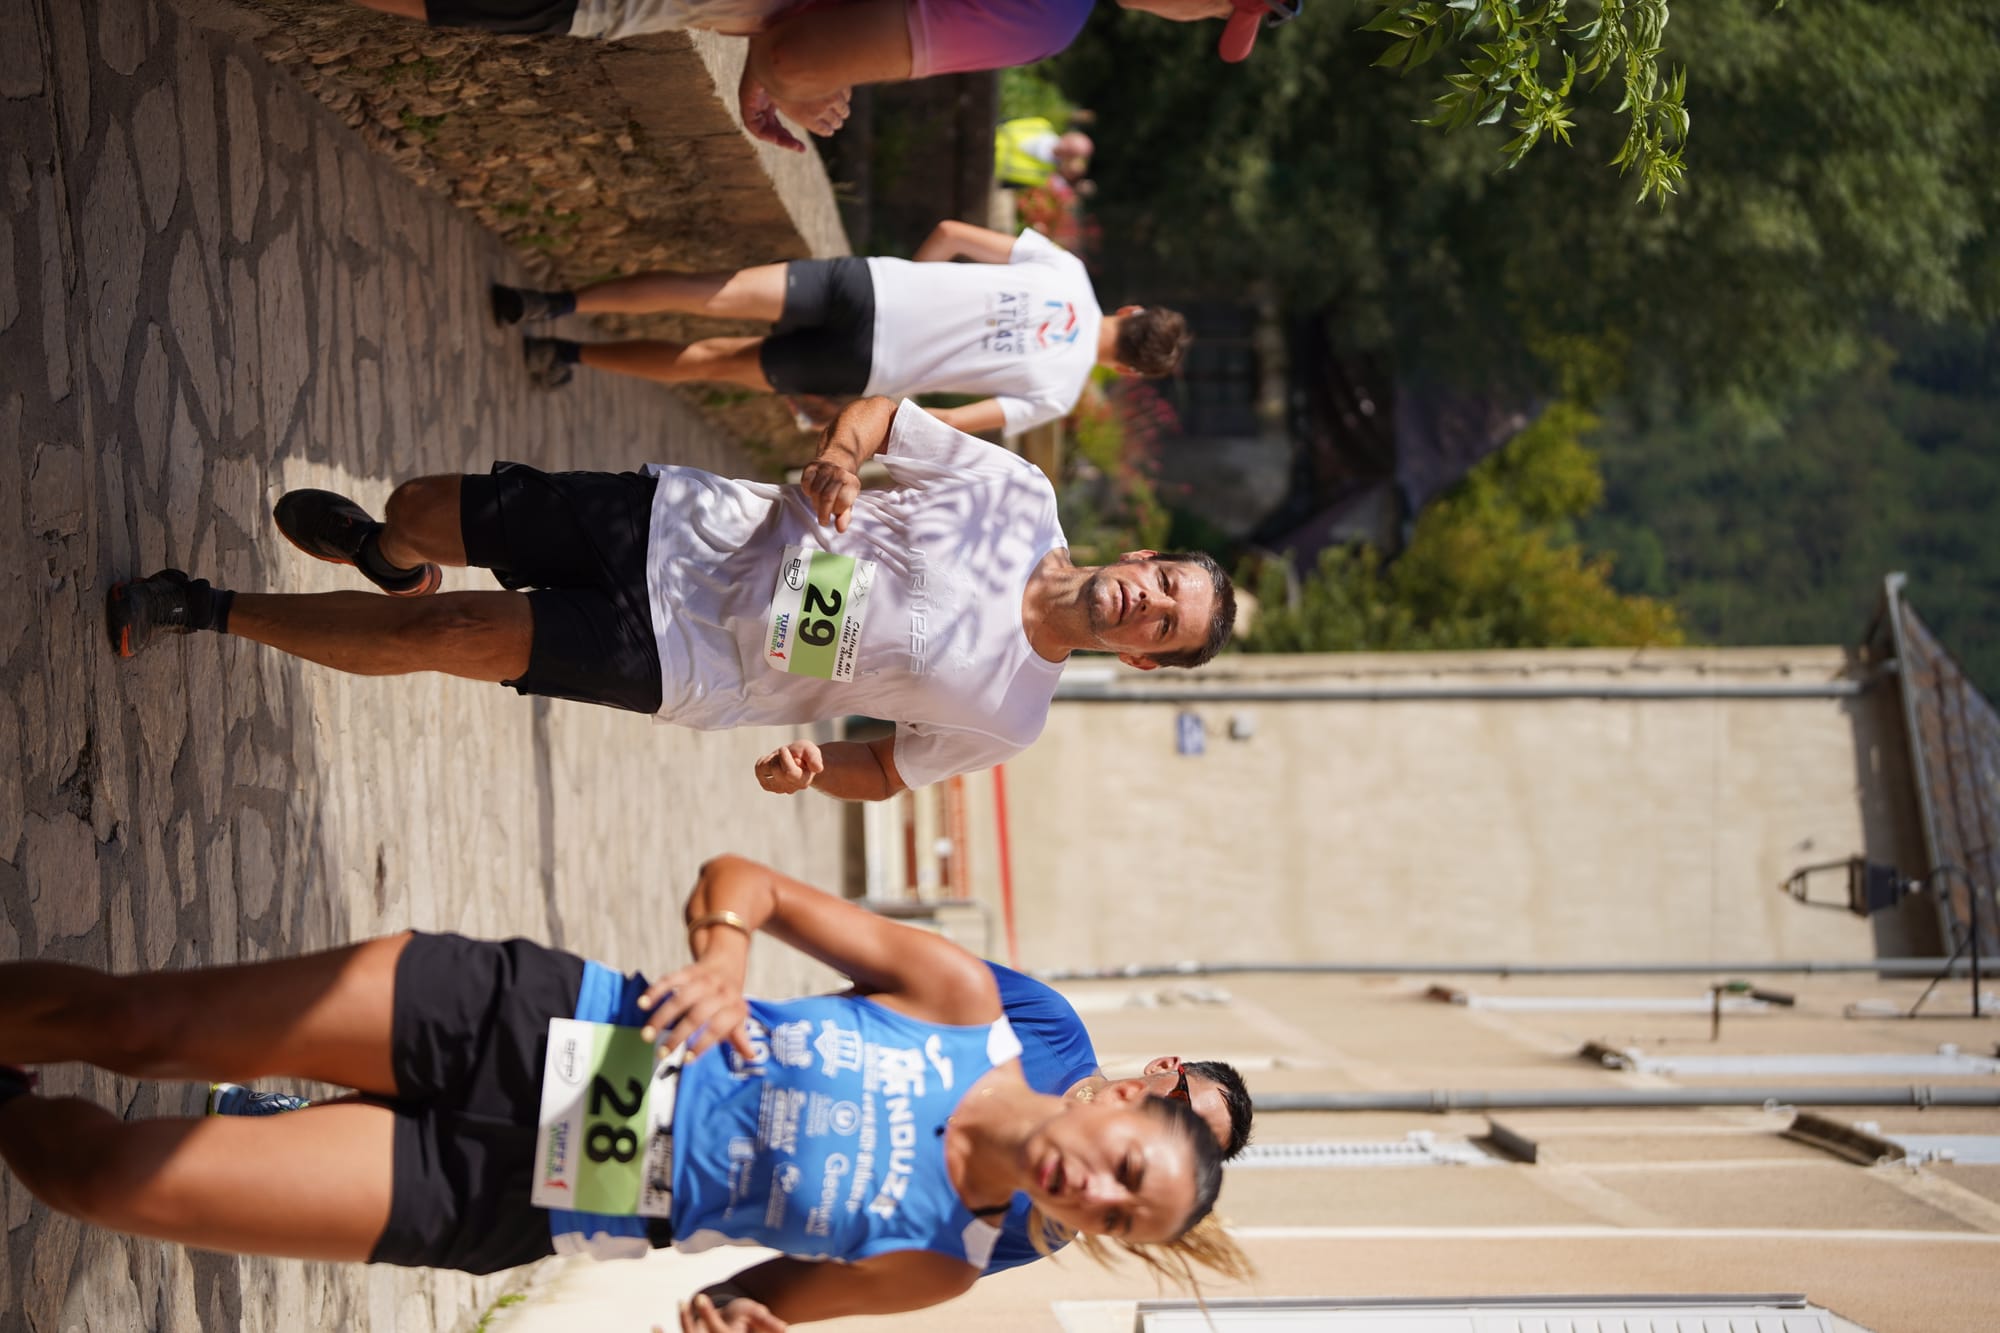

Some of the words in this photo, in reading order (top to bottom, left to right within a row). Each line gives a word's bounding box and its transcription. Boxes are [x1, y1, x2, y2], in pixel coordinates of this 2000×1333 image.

[994, 291, 1016, 352] ATLAS
[789, 558, 802, 586] BFP
[776, 613, 790, 648] TUFF'S
[798, 583, 842, 647] 29
[842, 616, 852, 643] vallées
[846, 621, 860, 659] Challenge
[844, 662, 852, 674] des
[585, 1074, 644, 1164] 28
